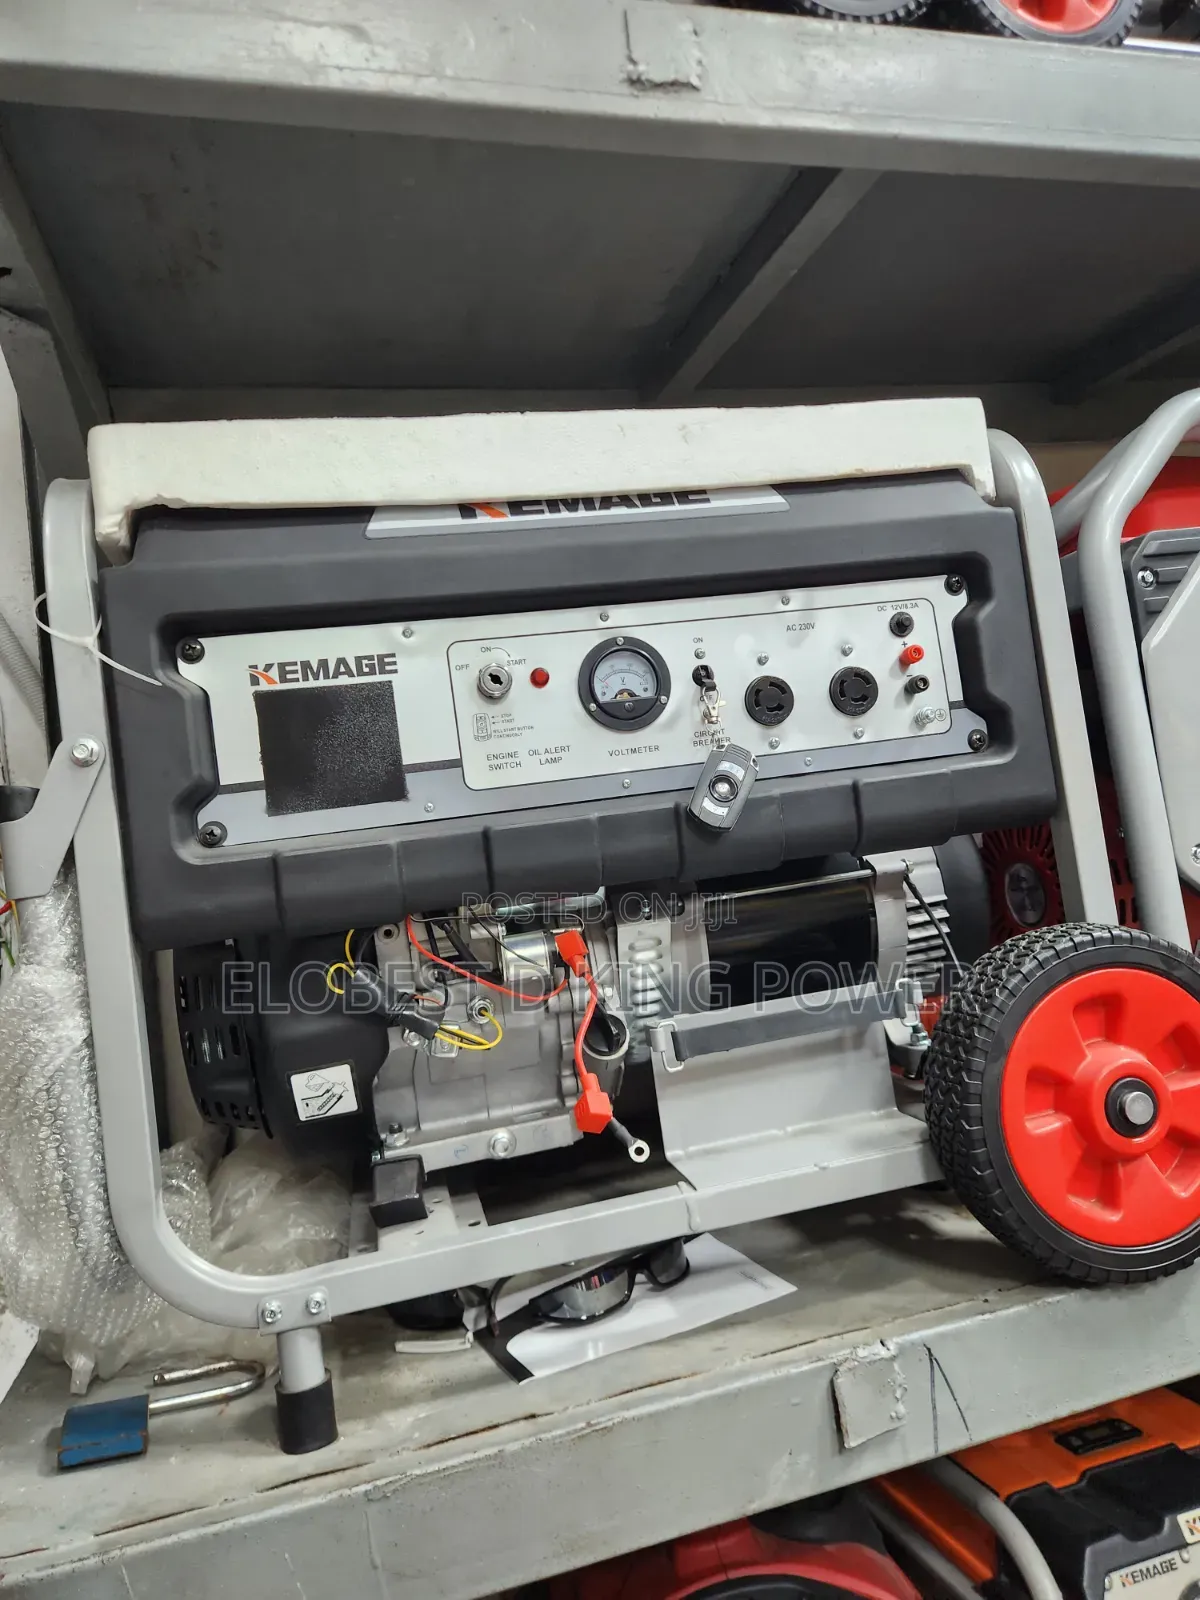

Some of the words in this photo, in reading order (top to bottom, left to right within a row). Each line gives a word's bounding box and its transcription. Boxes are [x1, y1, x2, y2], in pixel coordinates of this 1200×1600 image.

[786, 624, 797, 632] AC
[798, 622, 816, 631] 230V
[455, 663, 470, 671] OFF
[506, 658, 527, 667] START
[245, 652, 398, 687] KEMAGE
[486, 751, 520, 762] ENGINE
[528, 749, 542, 757] OIL
[544, 745, 571, 755] ALERT
[608, 745, 660, 757] VOLTMETER
[488, 760, 522, 771] SWITCH
[539, 756, 563, 766] LAMP
[1119, 1557, 1179, 1588] KEMAGE
